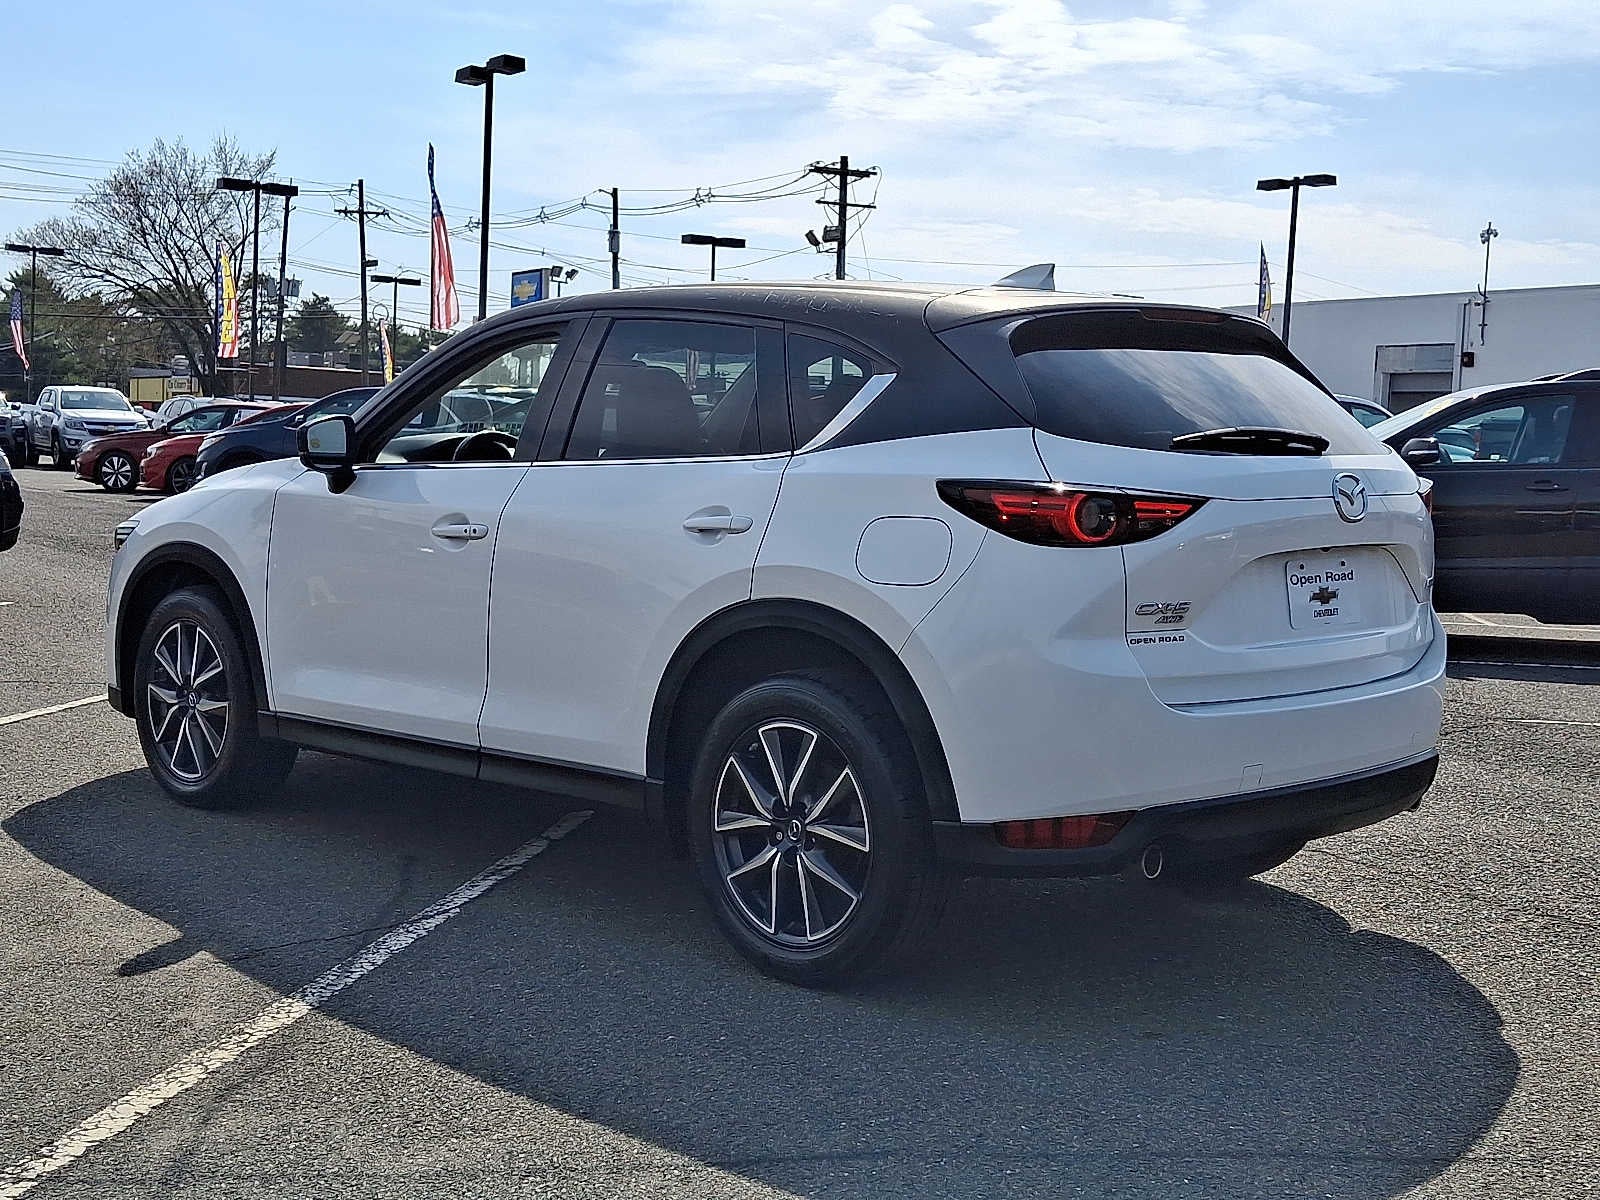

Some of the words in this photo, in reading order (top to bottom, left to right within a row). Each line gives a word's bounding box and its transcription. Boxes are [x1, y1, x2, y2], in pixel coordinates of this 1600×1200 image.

[1290, 574, 1322, 587] Open
[1325, 569, 1354, 582] Road
[1134, 600, 1192, 615] CX-5
[1154, 615, 1184, 624] AWD
[1129, 637, 1156, 645] OPEN
[1159, 635, 1185, 643] ROAD
